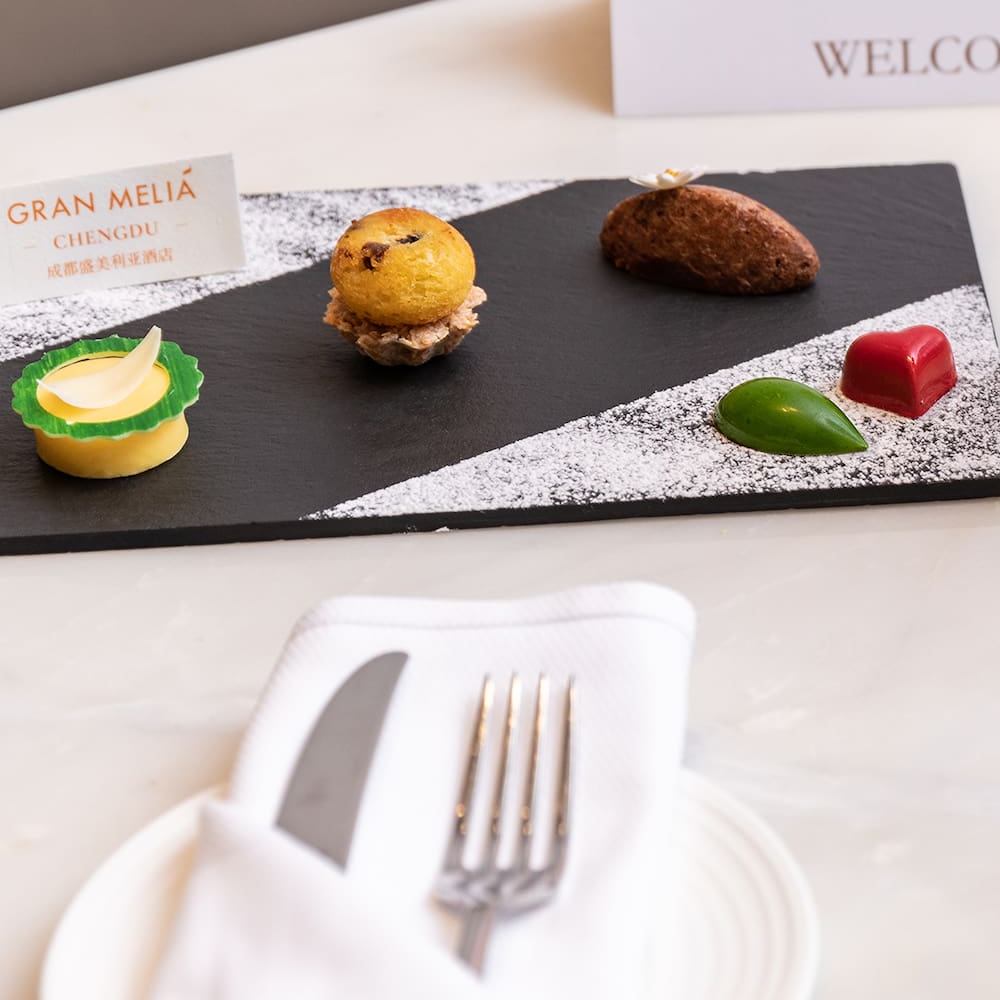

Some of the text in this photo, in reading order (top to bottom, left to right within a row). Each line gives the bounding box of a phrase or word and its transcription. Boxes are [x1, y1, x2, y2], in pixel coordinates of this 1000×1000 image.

[7, 167, 197, 225] GRAN MELIÁ
[53, 221, 159, 249] CHENGDU
[47, 247, 173, 279] 成都盛美利亚酒店
